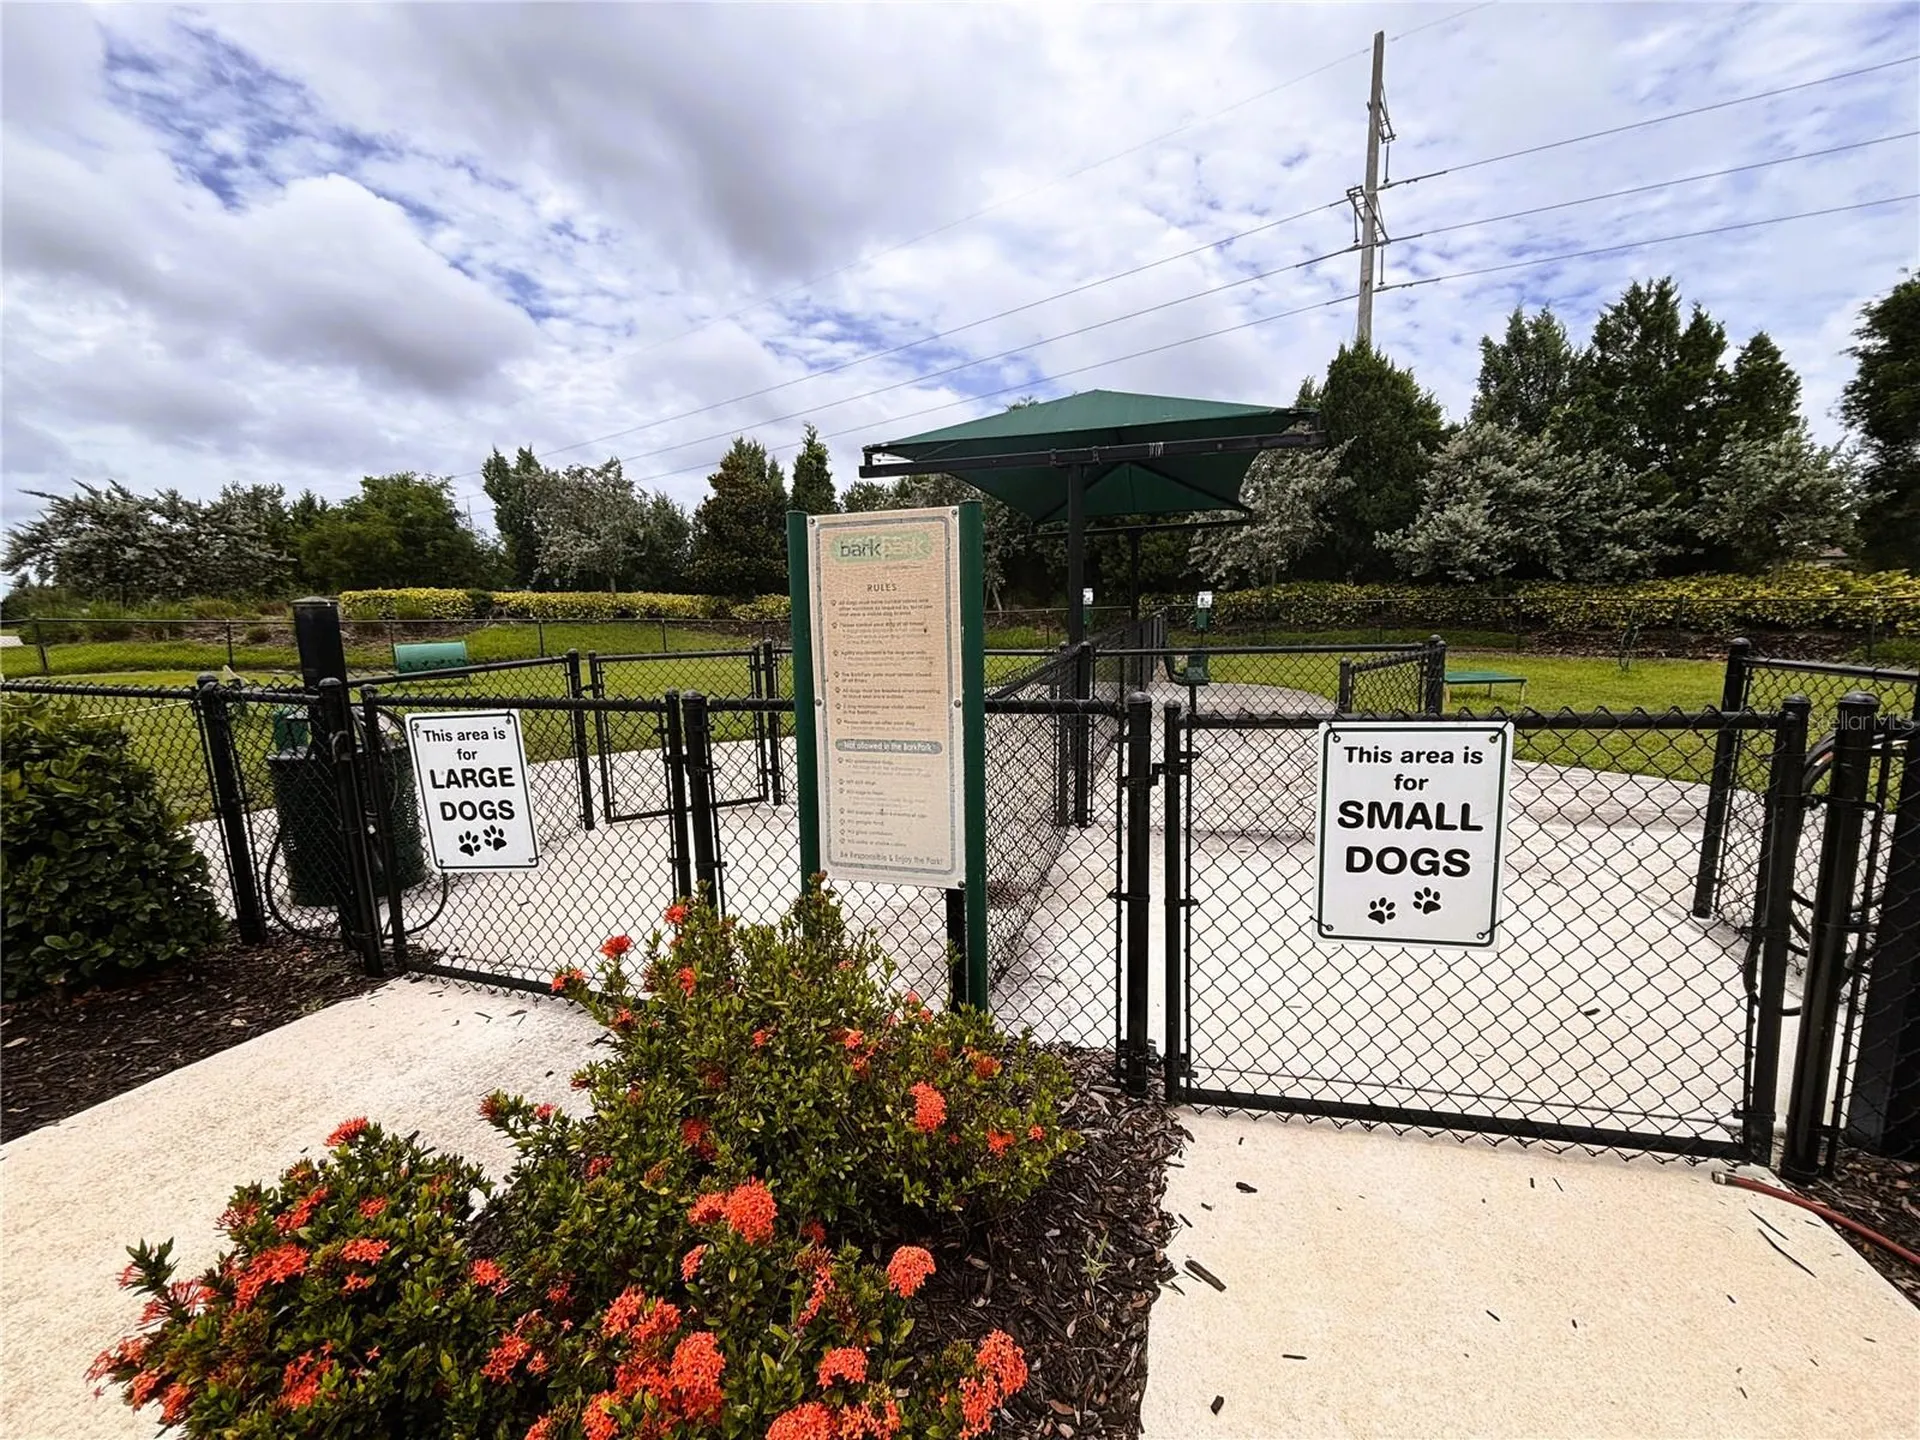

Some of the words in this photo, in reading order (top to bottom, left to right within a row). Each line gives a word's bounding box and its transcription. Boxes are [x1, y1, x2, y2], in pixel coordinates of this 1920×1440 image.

[867, 583, 897, 592] RULES
[423, 729, 453, 742] This
[457, 731, 489, 741] area
[493, 727, 506, 740] is
[456, 748, 478, 760] for
[1344, 746, 1392, 764] This
[1400, 750, 1454, 764] area
[1463, 746, 1484, 764] is
[429, 767, 515, 789] LARGE
[1394, 774, 1429, 791] for
[439, 800, 515, 821] DOGS
[1337, 801, 1484, 831] SMALL
[1345, 846, 1471, 877] DOGS
